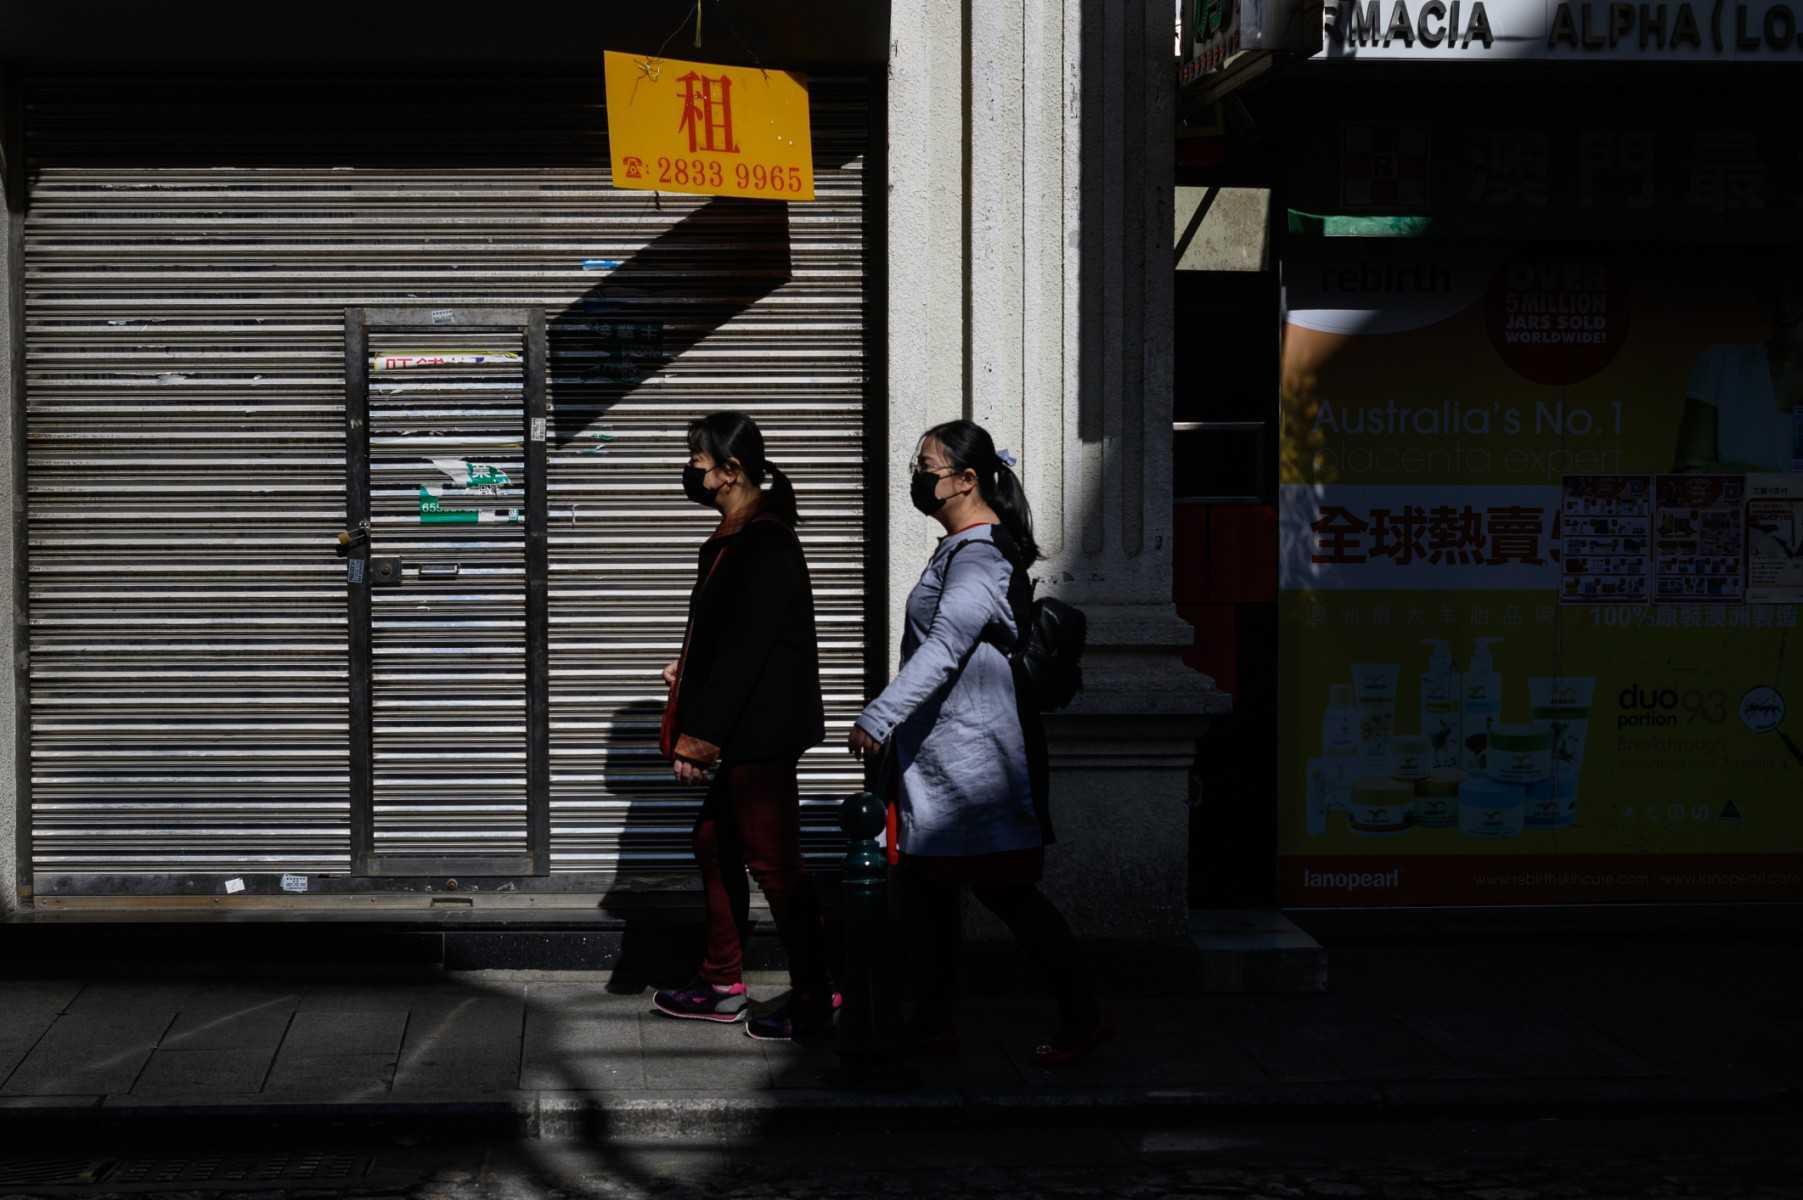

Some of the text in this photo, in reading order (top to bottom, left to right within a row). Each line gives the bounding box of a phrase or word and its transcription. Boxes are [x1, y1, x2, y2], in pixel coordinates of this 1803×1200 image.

[675, 70, 740, 153] 租
[657, 157, 801, 192] 2833 9965
[1321, 263, 1451, 292] rebirth
[1504, 330, 1608, 344] WORLDWIDE!
[1505, 314, 1607, 329] JARS SOLD
[1312, 400, 1521, 434] Australia's
[1312, 505, 1560, 566] 全球熱賣
[1618, 684, 1678, 709] duo
[1682, 687, 1728, 724] 93
[1617, 712, 1678, 730] portion
[1303, 864, 1399, 891] lanopearl
